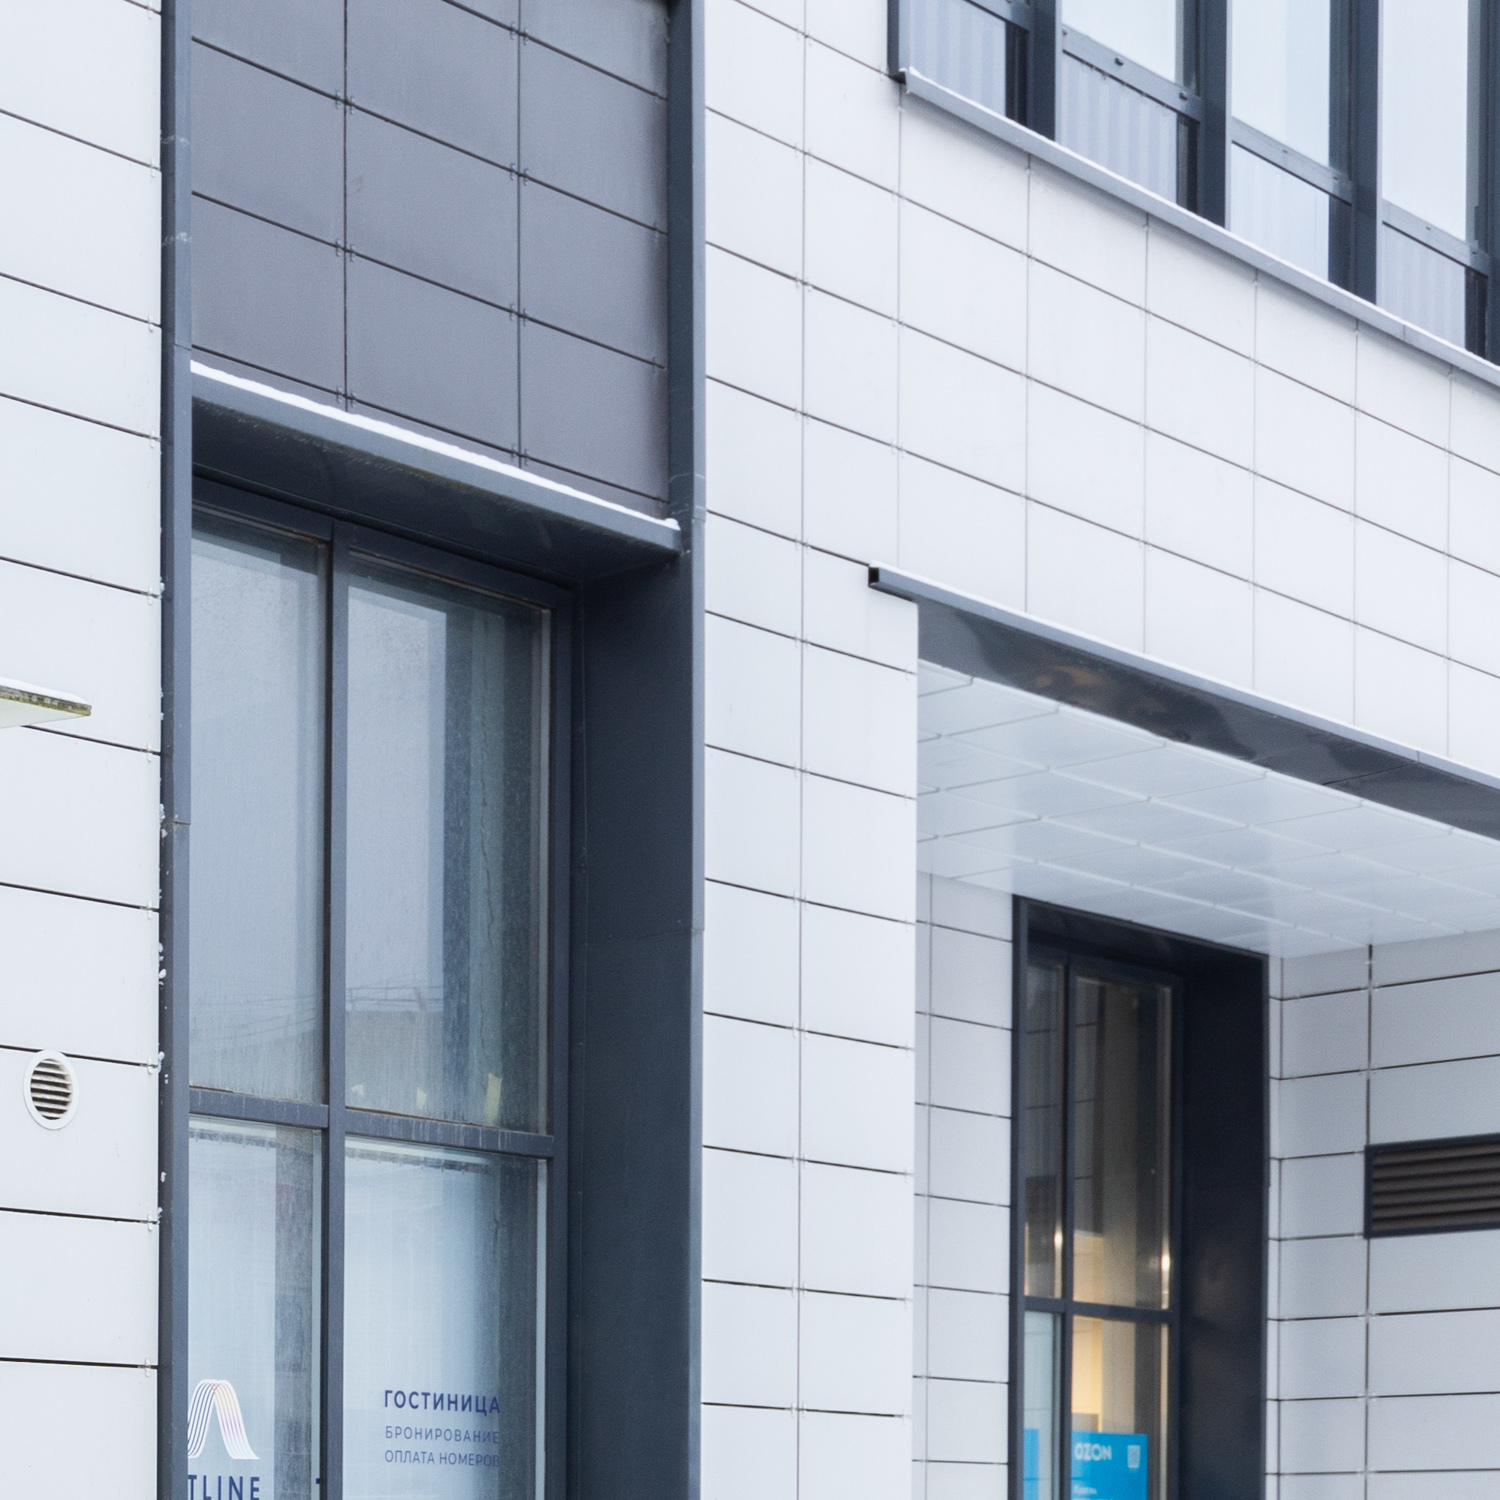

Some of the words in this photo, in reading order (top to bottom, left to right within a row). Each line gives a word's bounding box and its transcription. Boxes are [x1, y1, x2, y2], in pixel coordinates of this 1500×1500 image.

[385, 1390, 500, 1416] ГОСТИНИЦА
[385, 1426, 500, 1443] БРОНИРОВАНИЕ
[385, 1450, 435, 1465] ОПЛАТА
[440, 1453, 500, 1467] НОМЕРОВ
[1074, 1443, 1112, 1461] OZON
